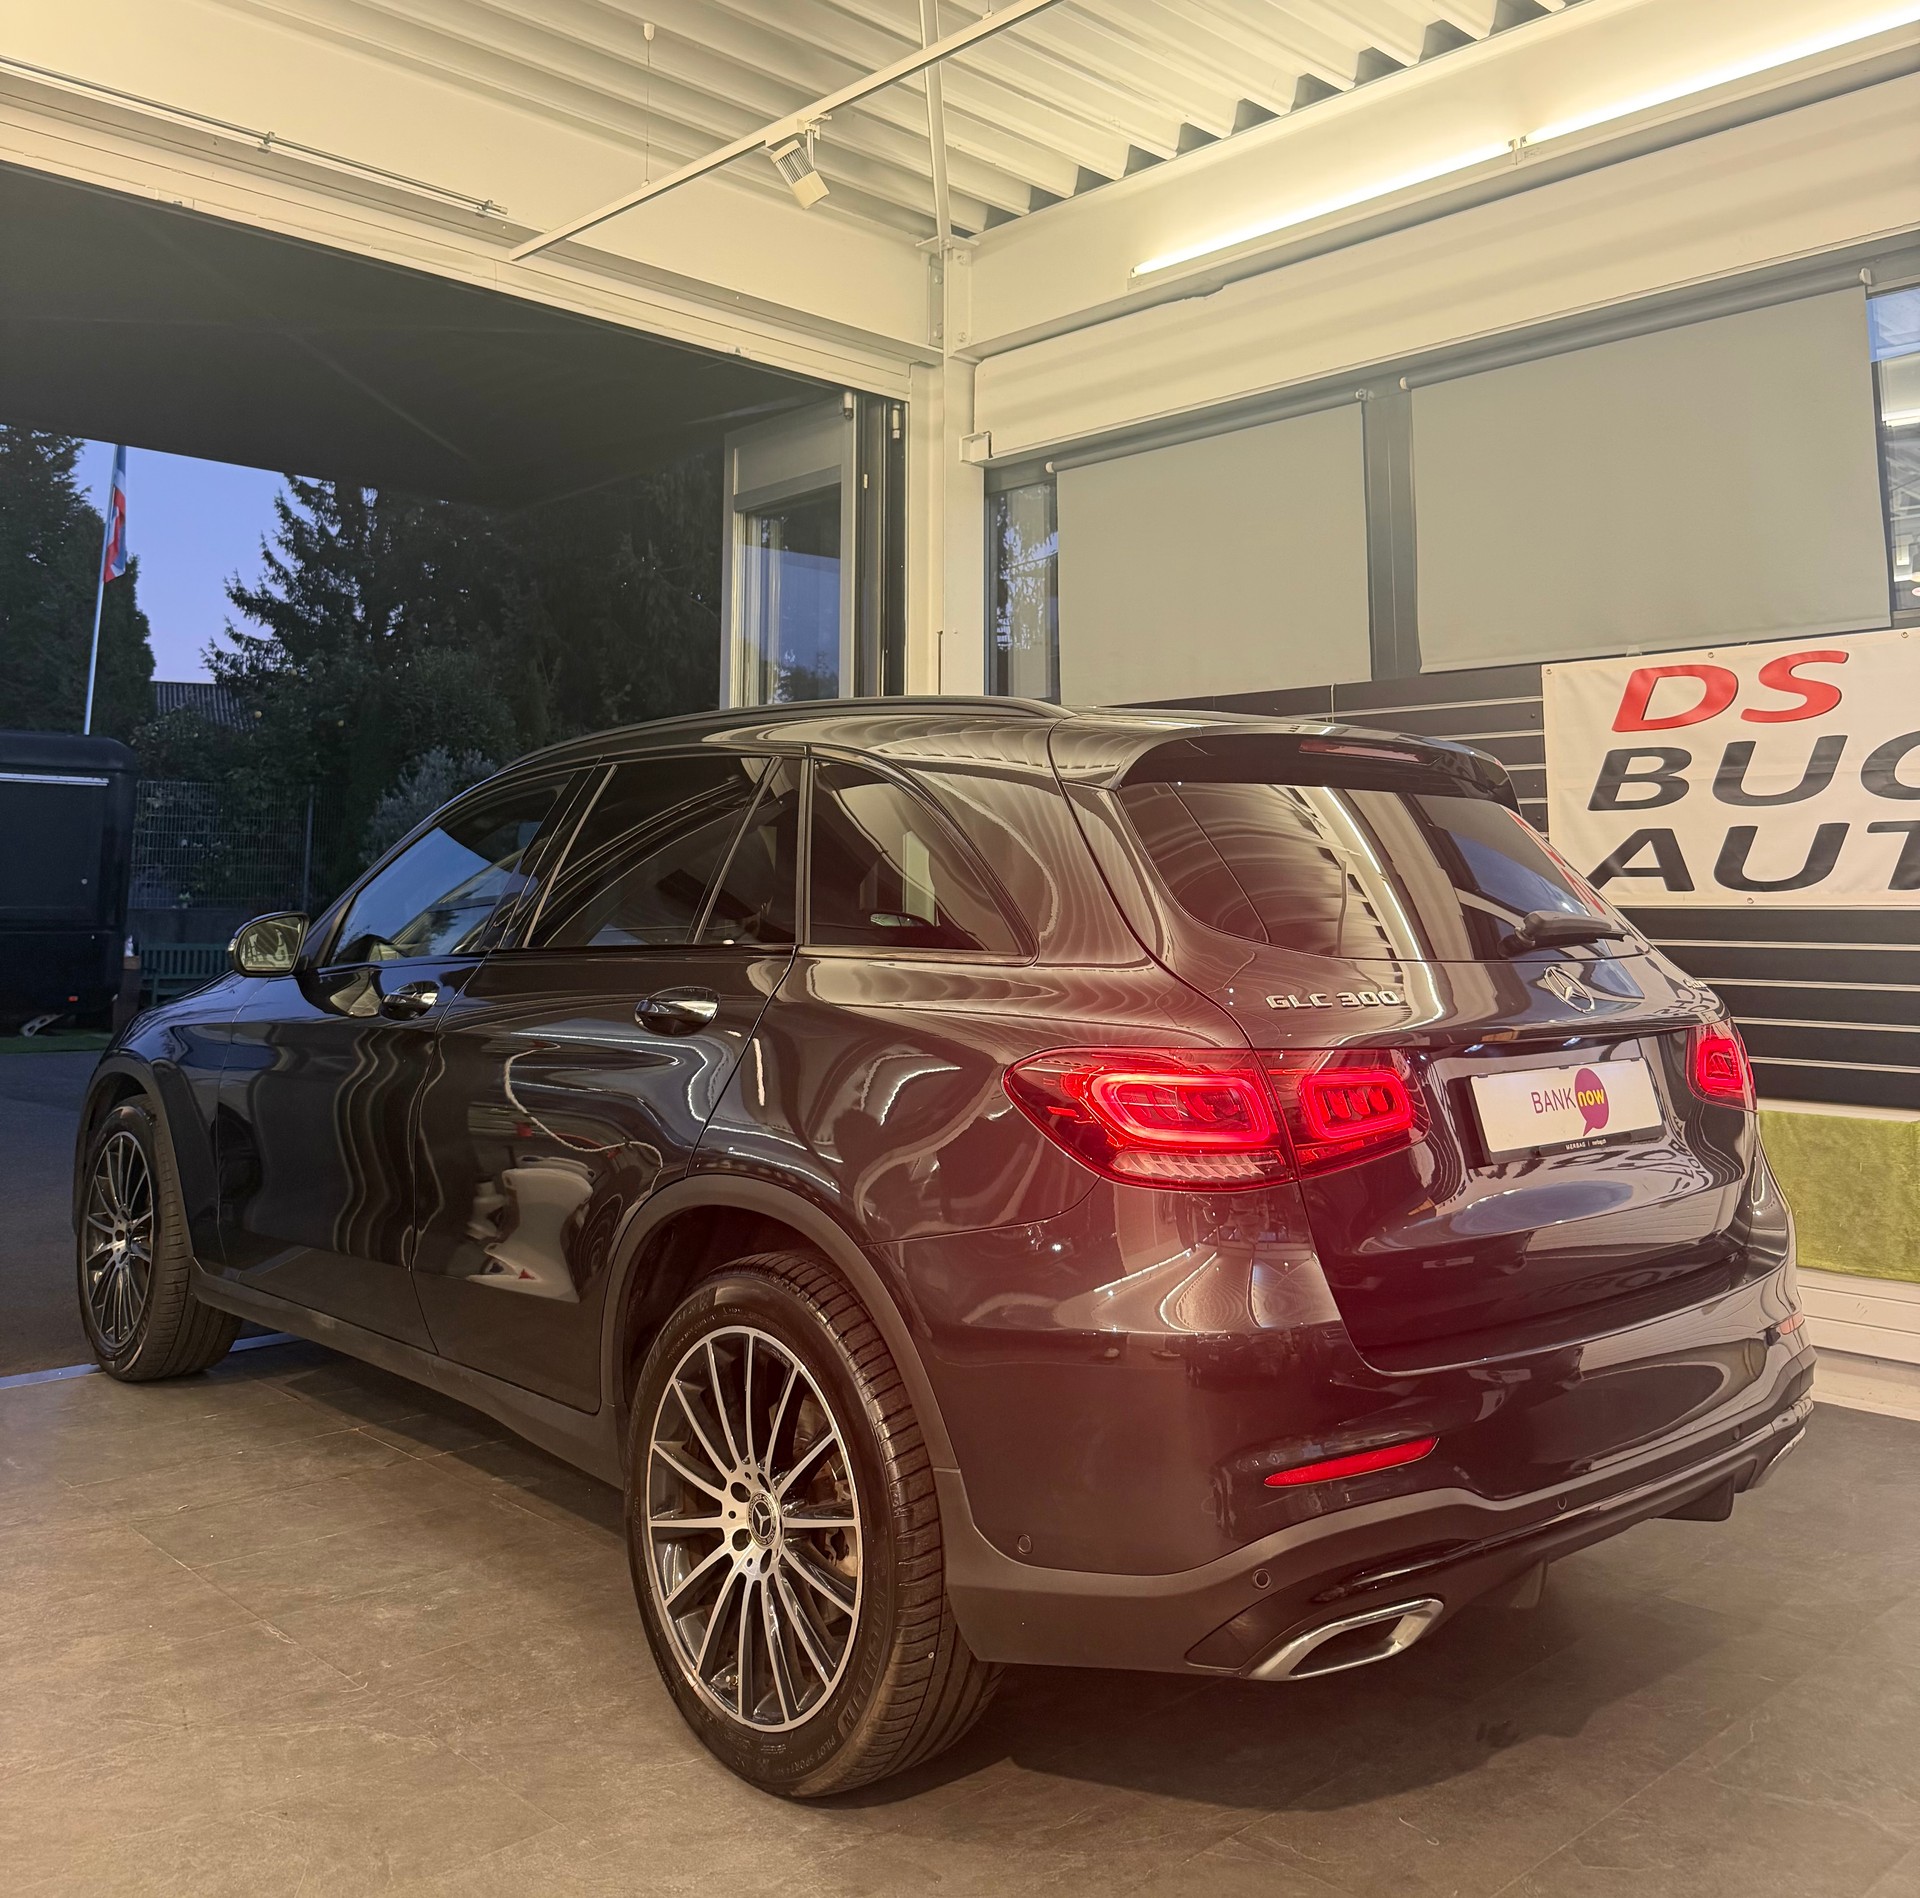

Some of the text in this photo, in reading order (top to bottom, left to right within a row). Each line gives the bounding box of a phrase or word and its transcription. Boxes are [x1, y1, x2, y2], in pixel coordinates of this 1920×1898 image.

[1612, 650, 1850, 732] DS
[1265, 990, 1401, 1009] GLC 300
[1531, 1088, 1604, 1114] BANK now
